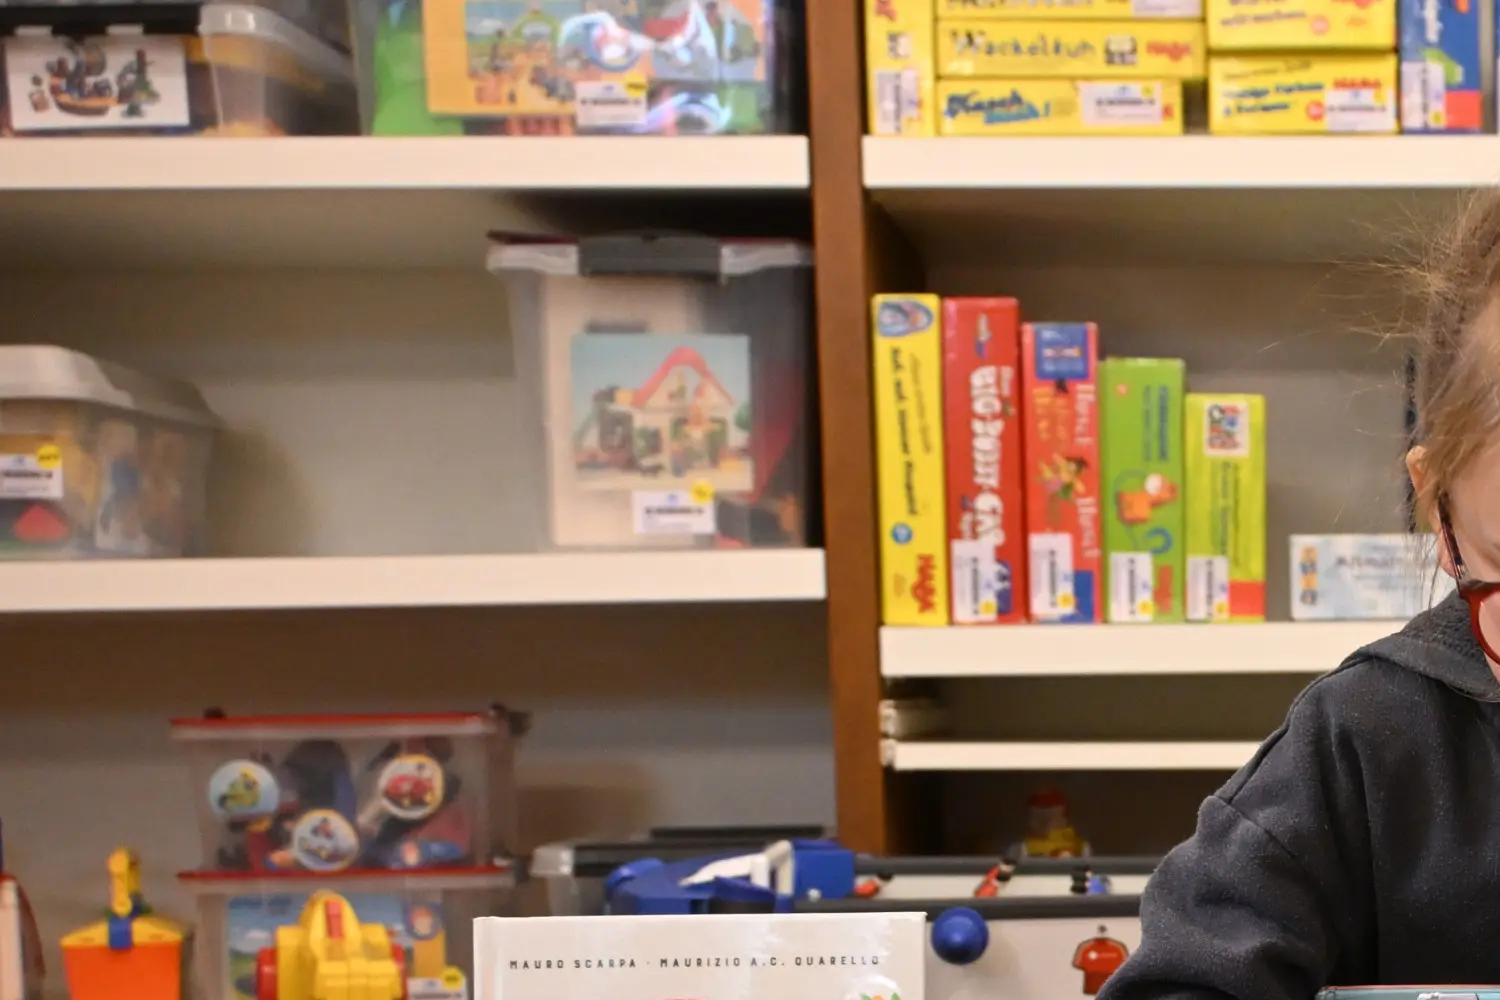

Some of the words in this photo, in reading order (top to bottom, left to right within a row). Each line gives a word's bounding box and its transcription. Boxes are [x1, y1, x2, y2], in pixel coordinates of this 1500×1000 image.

[509, 959, 564, 969] MAURO
[573, 958, 636, 969] SCARPA
[660, 957, 740, 968] MAURIZIO
[750, 956, 785, 967] A.C.
[794, 955, 879, 967] QUARELLO
